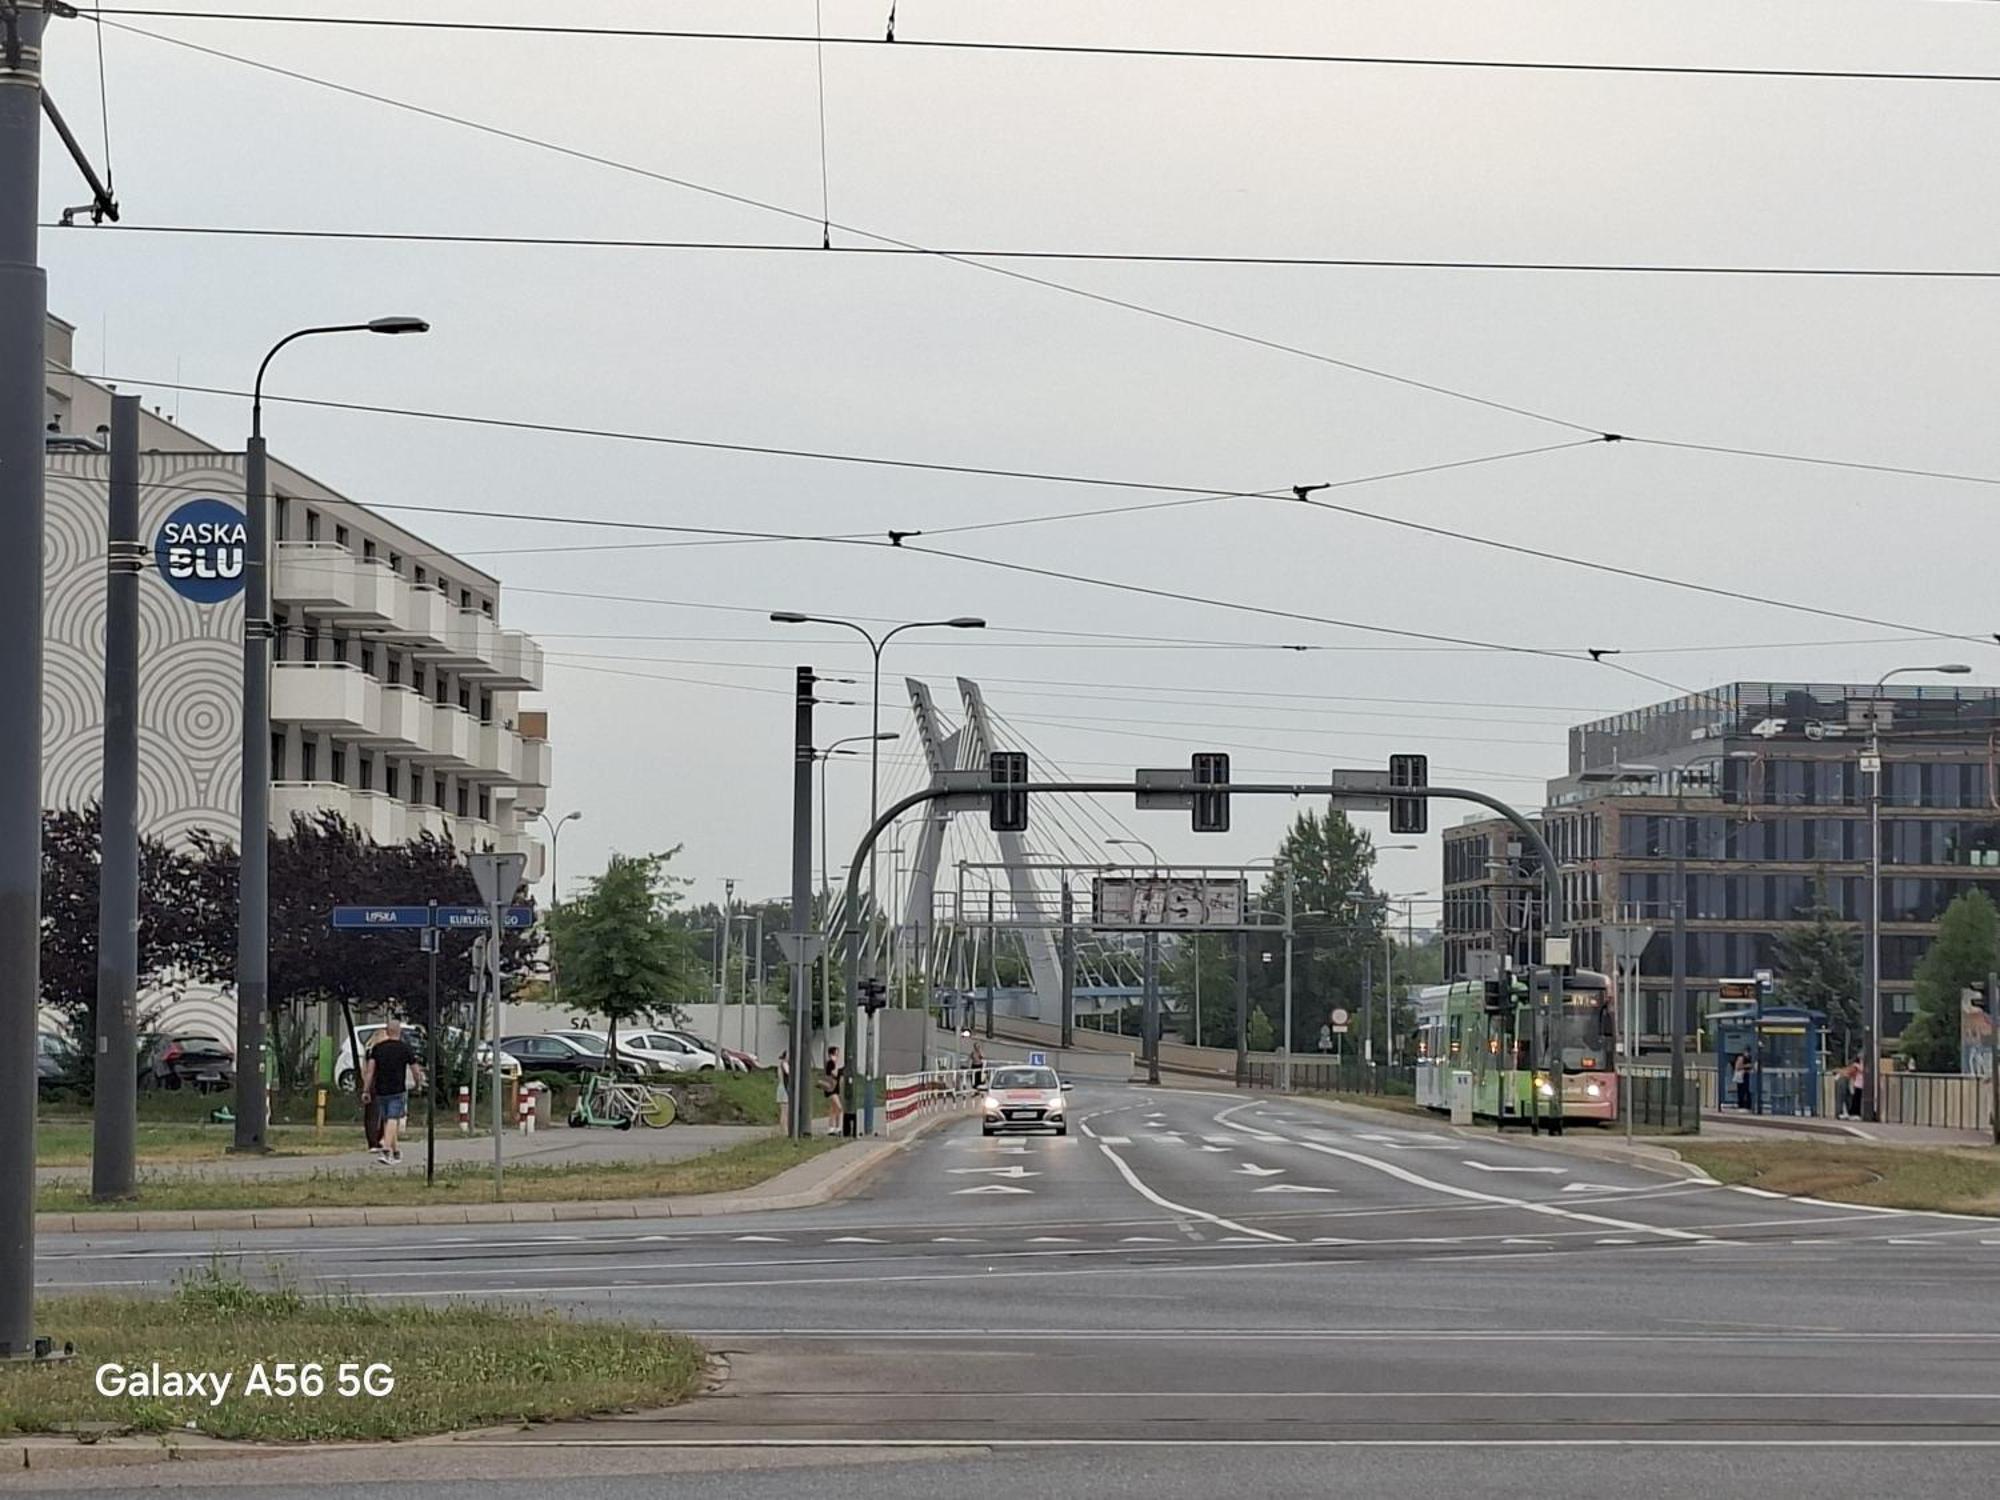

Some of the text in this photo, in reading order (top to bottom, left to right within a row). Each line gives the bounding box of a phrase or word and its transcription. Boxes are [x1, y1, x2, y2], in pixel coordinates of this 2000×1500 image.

[164, 522, 247, 544] SASKA
[169, 547, 243, 578] BLU
[365, 911, 398, 923] LIPSKA
